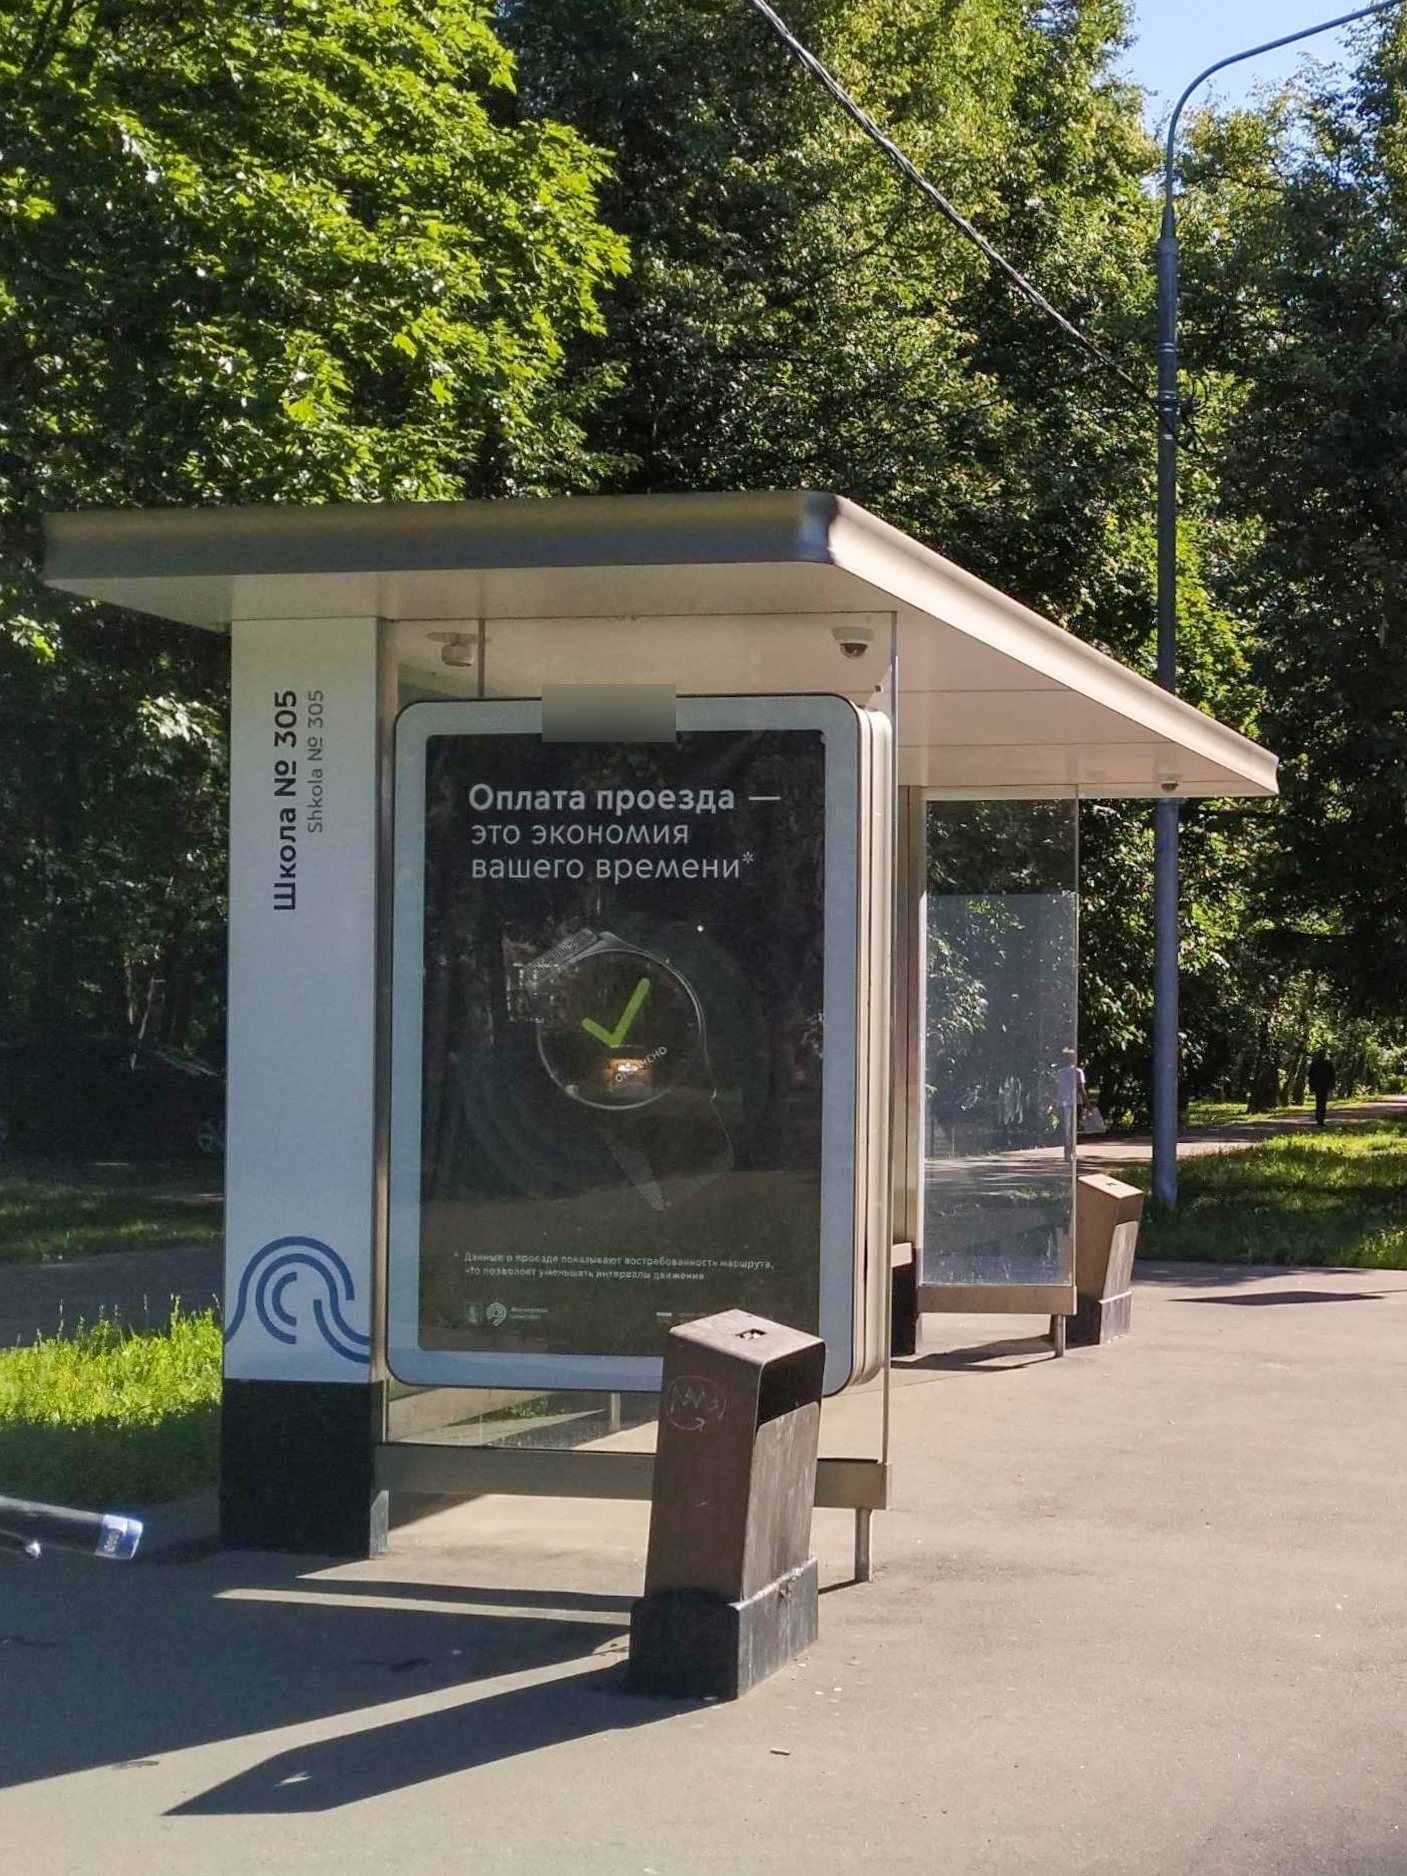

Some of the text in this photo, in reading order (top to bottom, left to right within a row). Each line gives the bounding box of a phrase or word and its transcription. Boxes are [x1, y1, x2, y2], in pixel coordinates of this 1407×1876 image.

[307, 689, 324, 834] Shkola № 305
[273, 690, 298, 911] Школа № 305
[469, 783, 585, 811] Оплата
[596, 788, 735, 817] проезда
[471, 824, 689, 845] это экономия
[471, 858, 584, 879] вашего
[614, 1046, 668, 1083] ОЧЕНО
[464, 1252, 504, 1263] Данные
[515, 1254, 558, 1264] проезде
